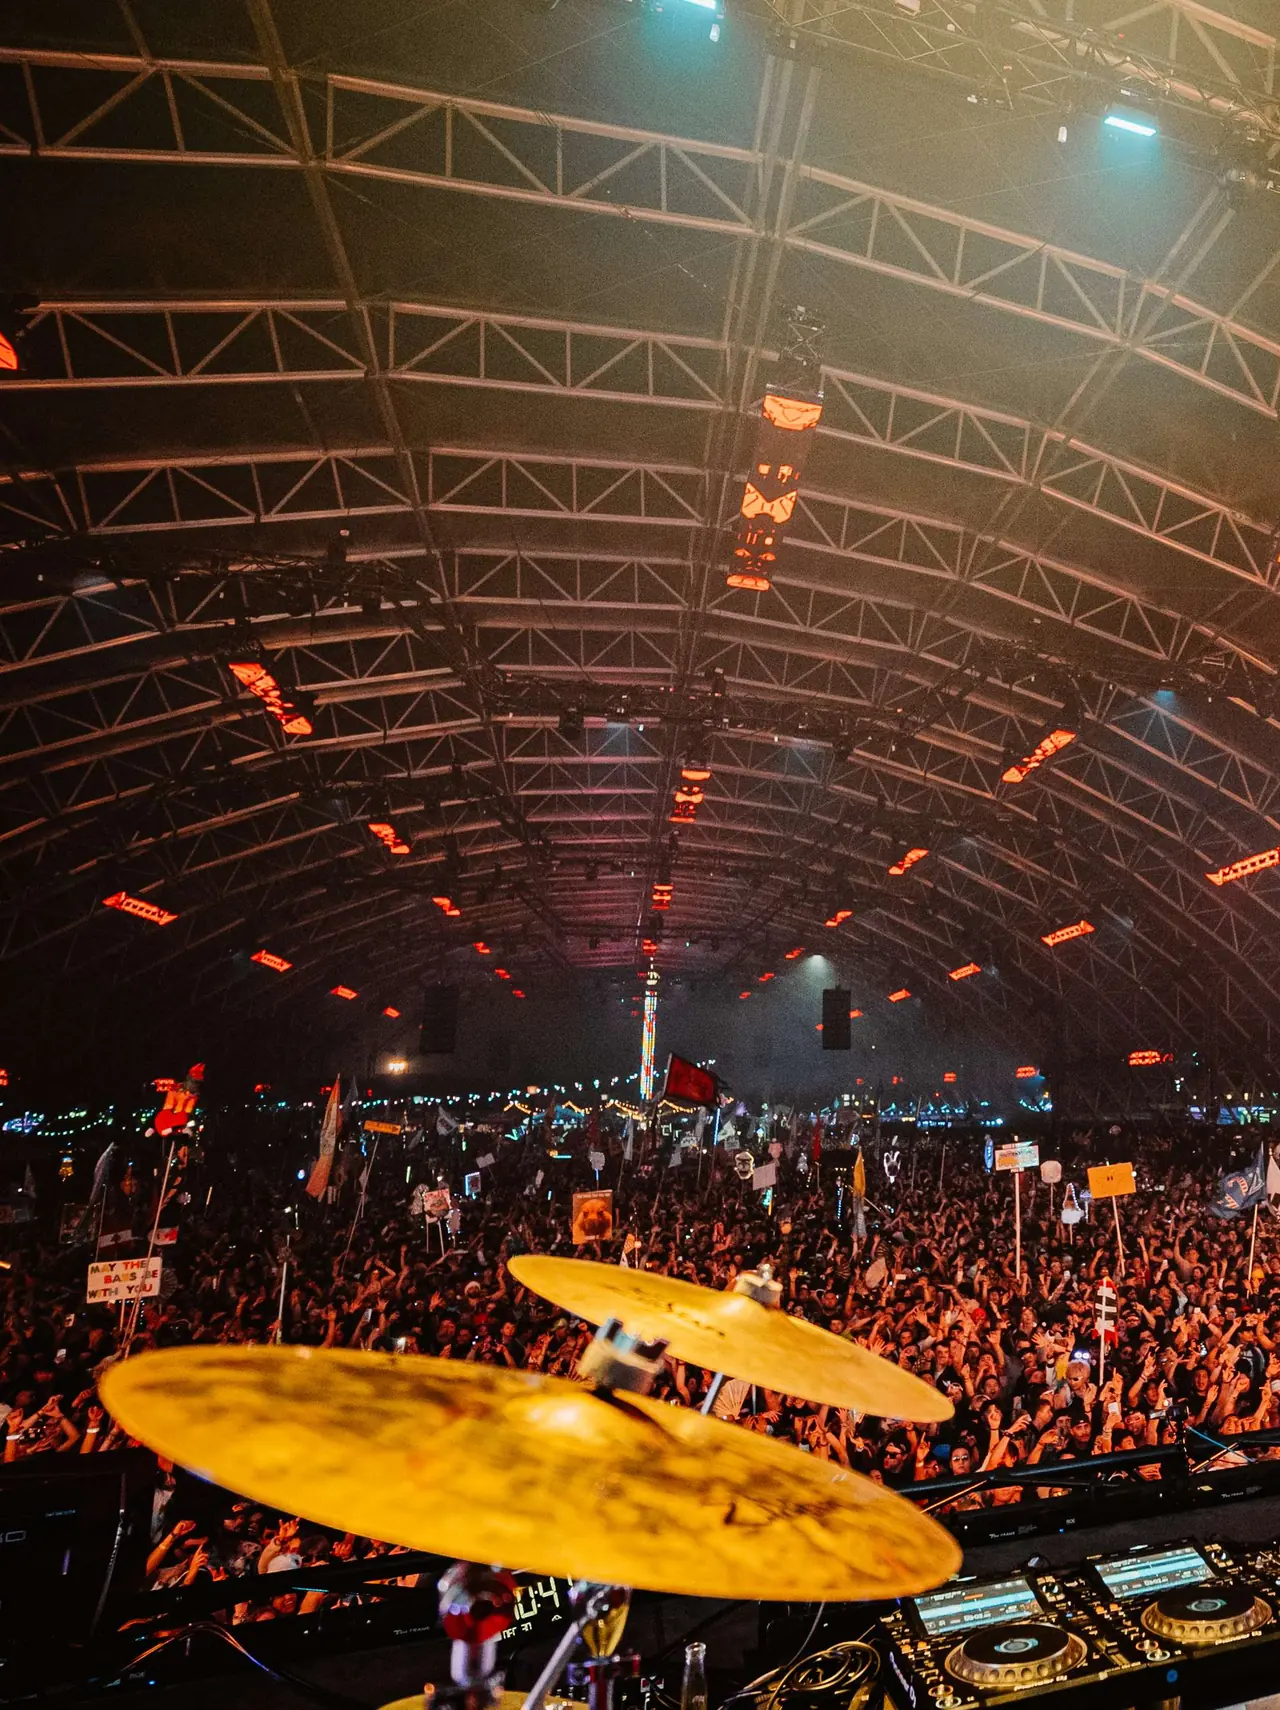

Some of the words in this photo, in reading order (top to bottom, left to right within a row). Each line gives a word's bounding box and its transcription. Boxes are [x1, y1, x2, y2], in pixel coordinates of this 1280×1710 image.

[90, 1263, 116, 1274] MAY
[122, 1260, 147, 1270] THE
[104, 1272, 137, 1284] BASS
[88, 1287, 119, 1299] WITH
[126, 1284, 153, 1295] YOU
